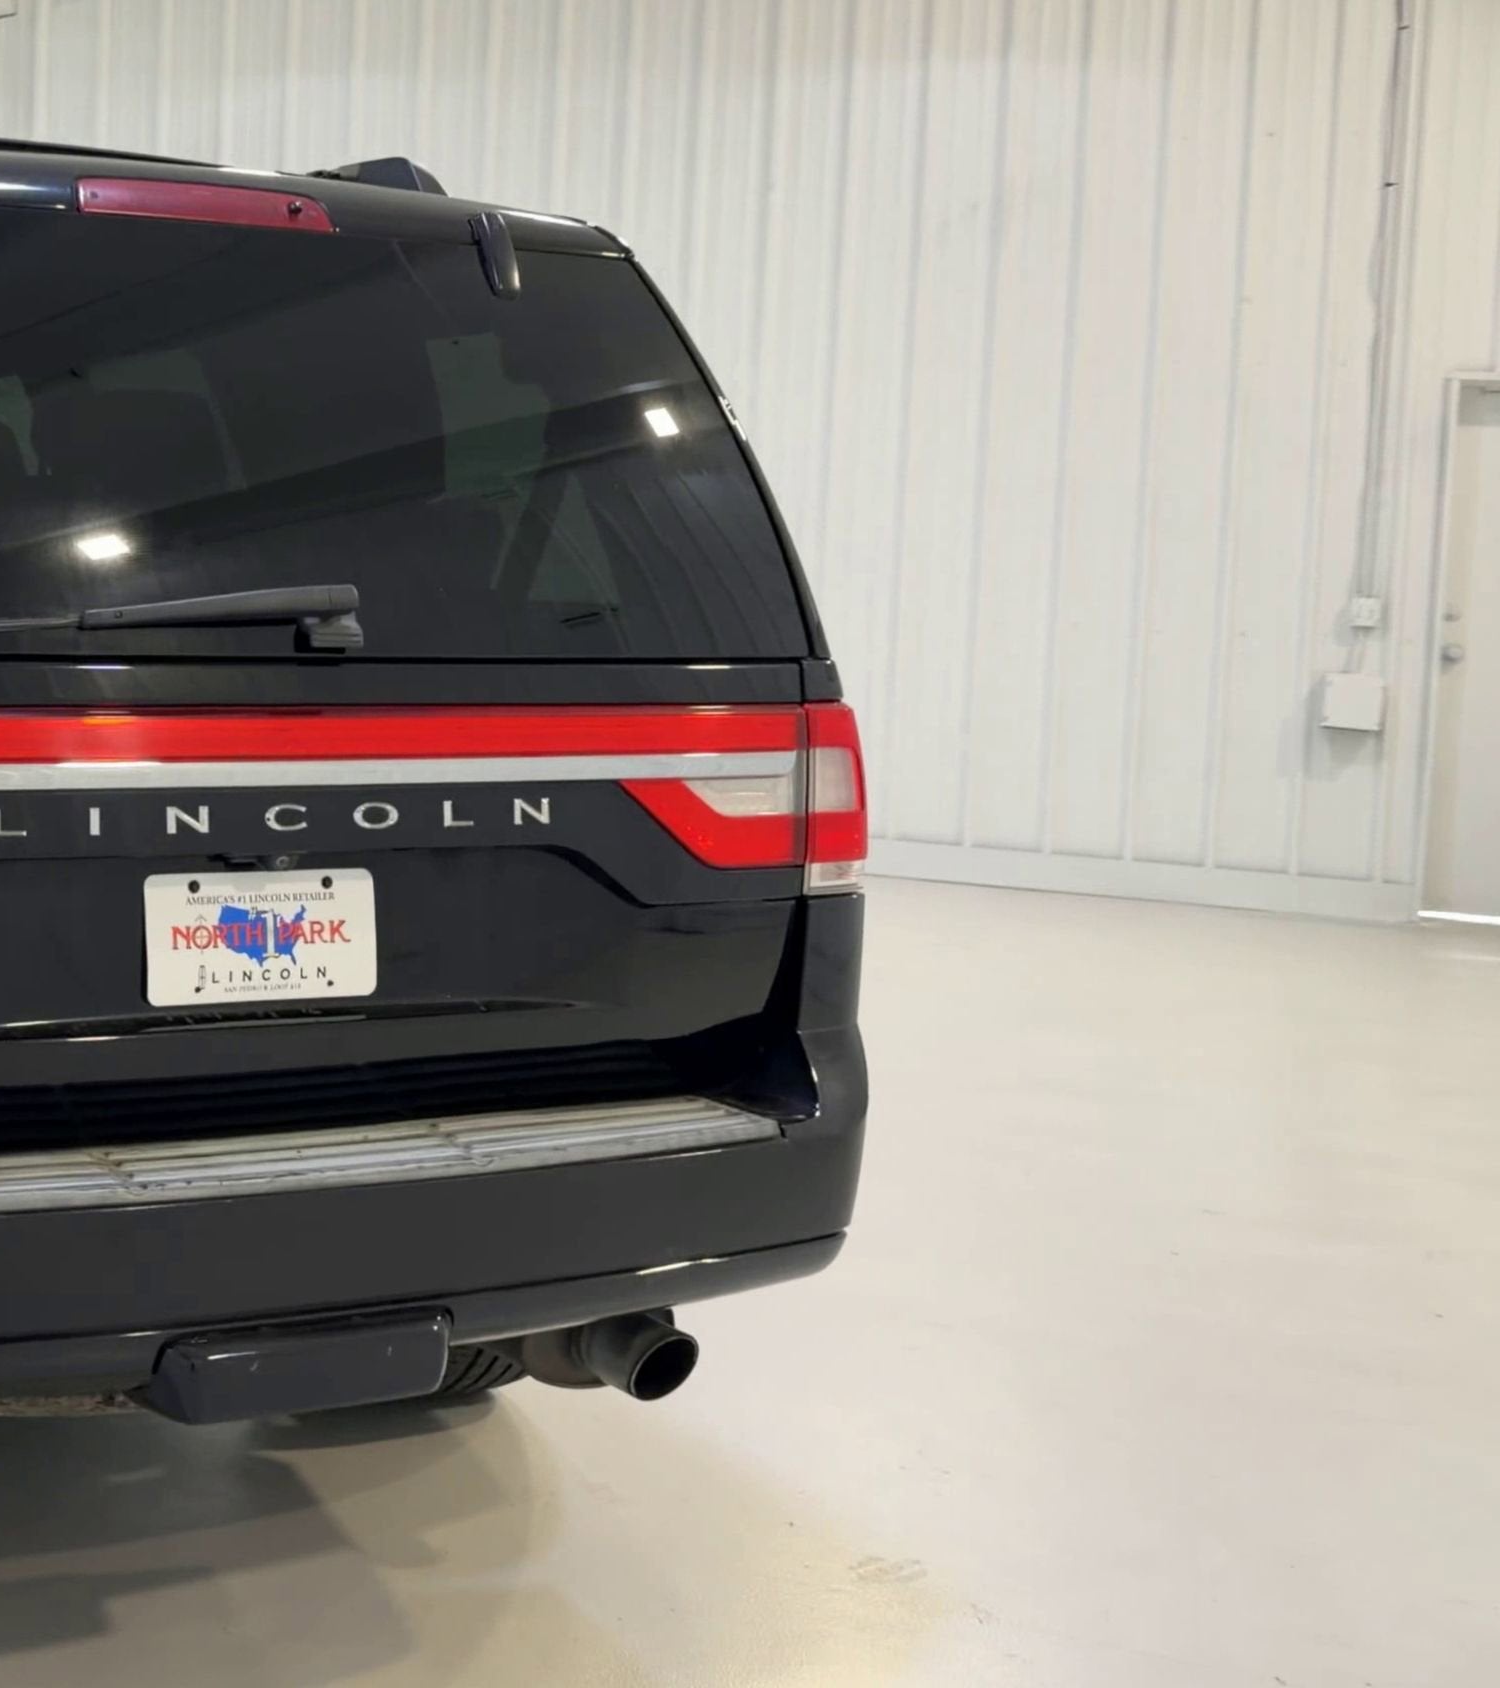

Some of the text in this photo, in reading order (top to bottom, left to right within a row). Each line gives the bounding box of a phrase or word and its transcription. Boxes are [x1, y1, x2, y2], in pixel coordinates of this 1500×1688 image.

[186, 892, 335, 906] AMERICA'S #1 LINCOLN RETAILER
[171, 919, 352, 950] NORTH PARK
[211, 966, 327, 984] LINCOLN
